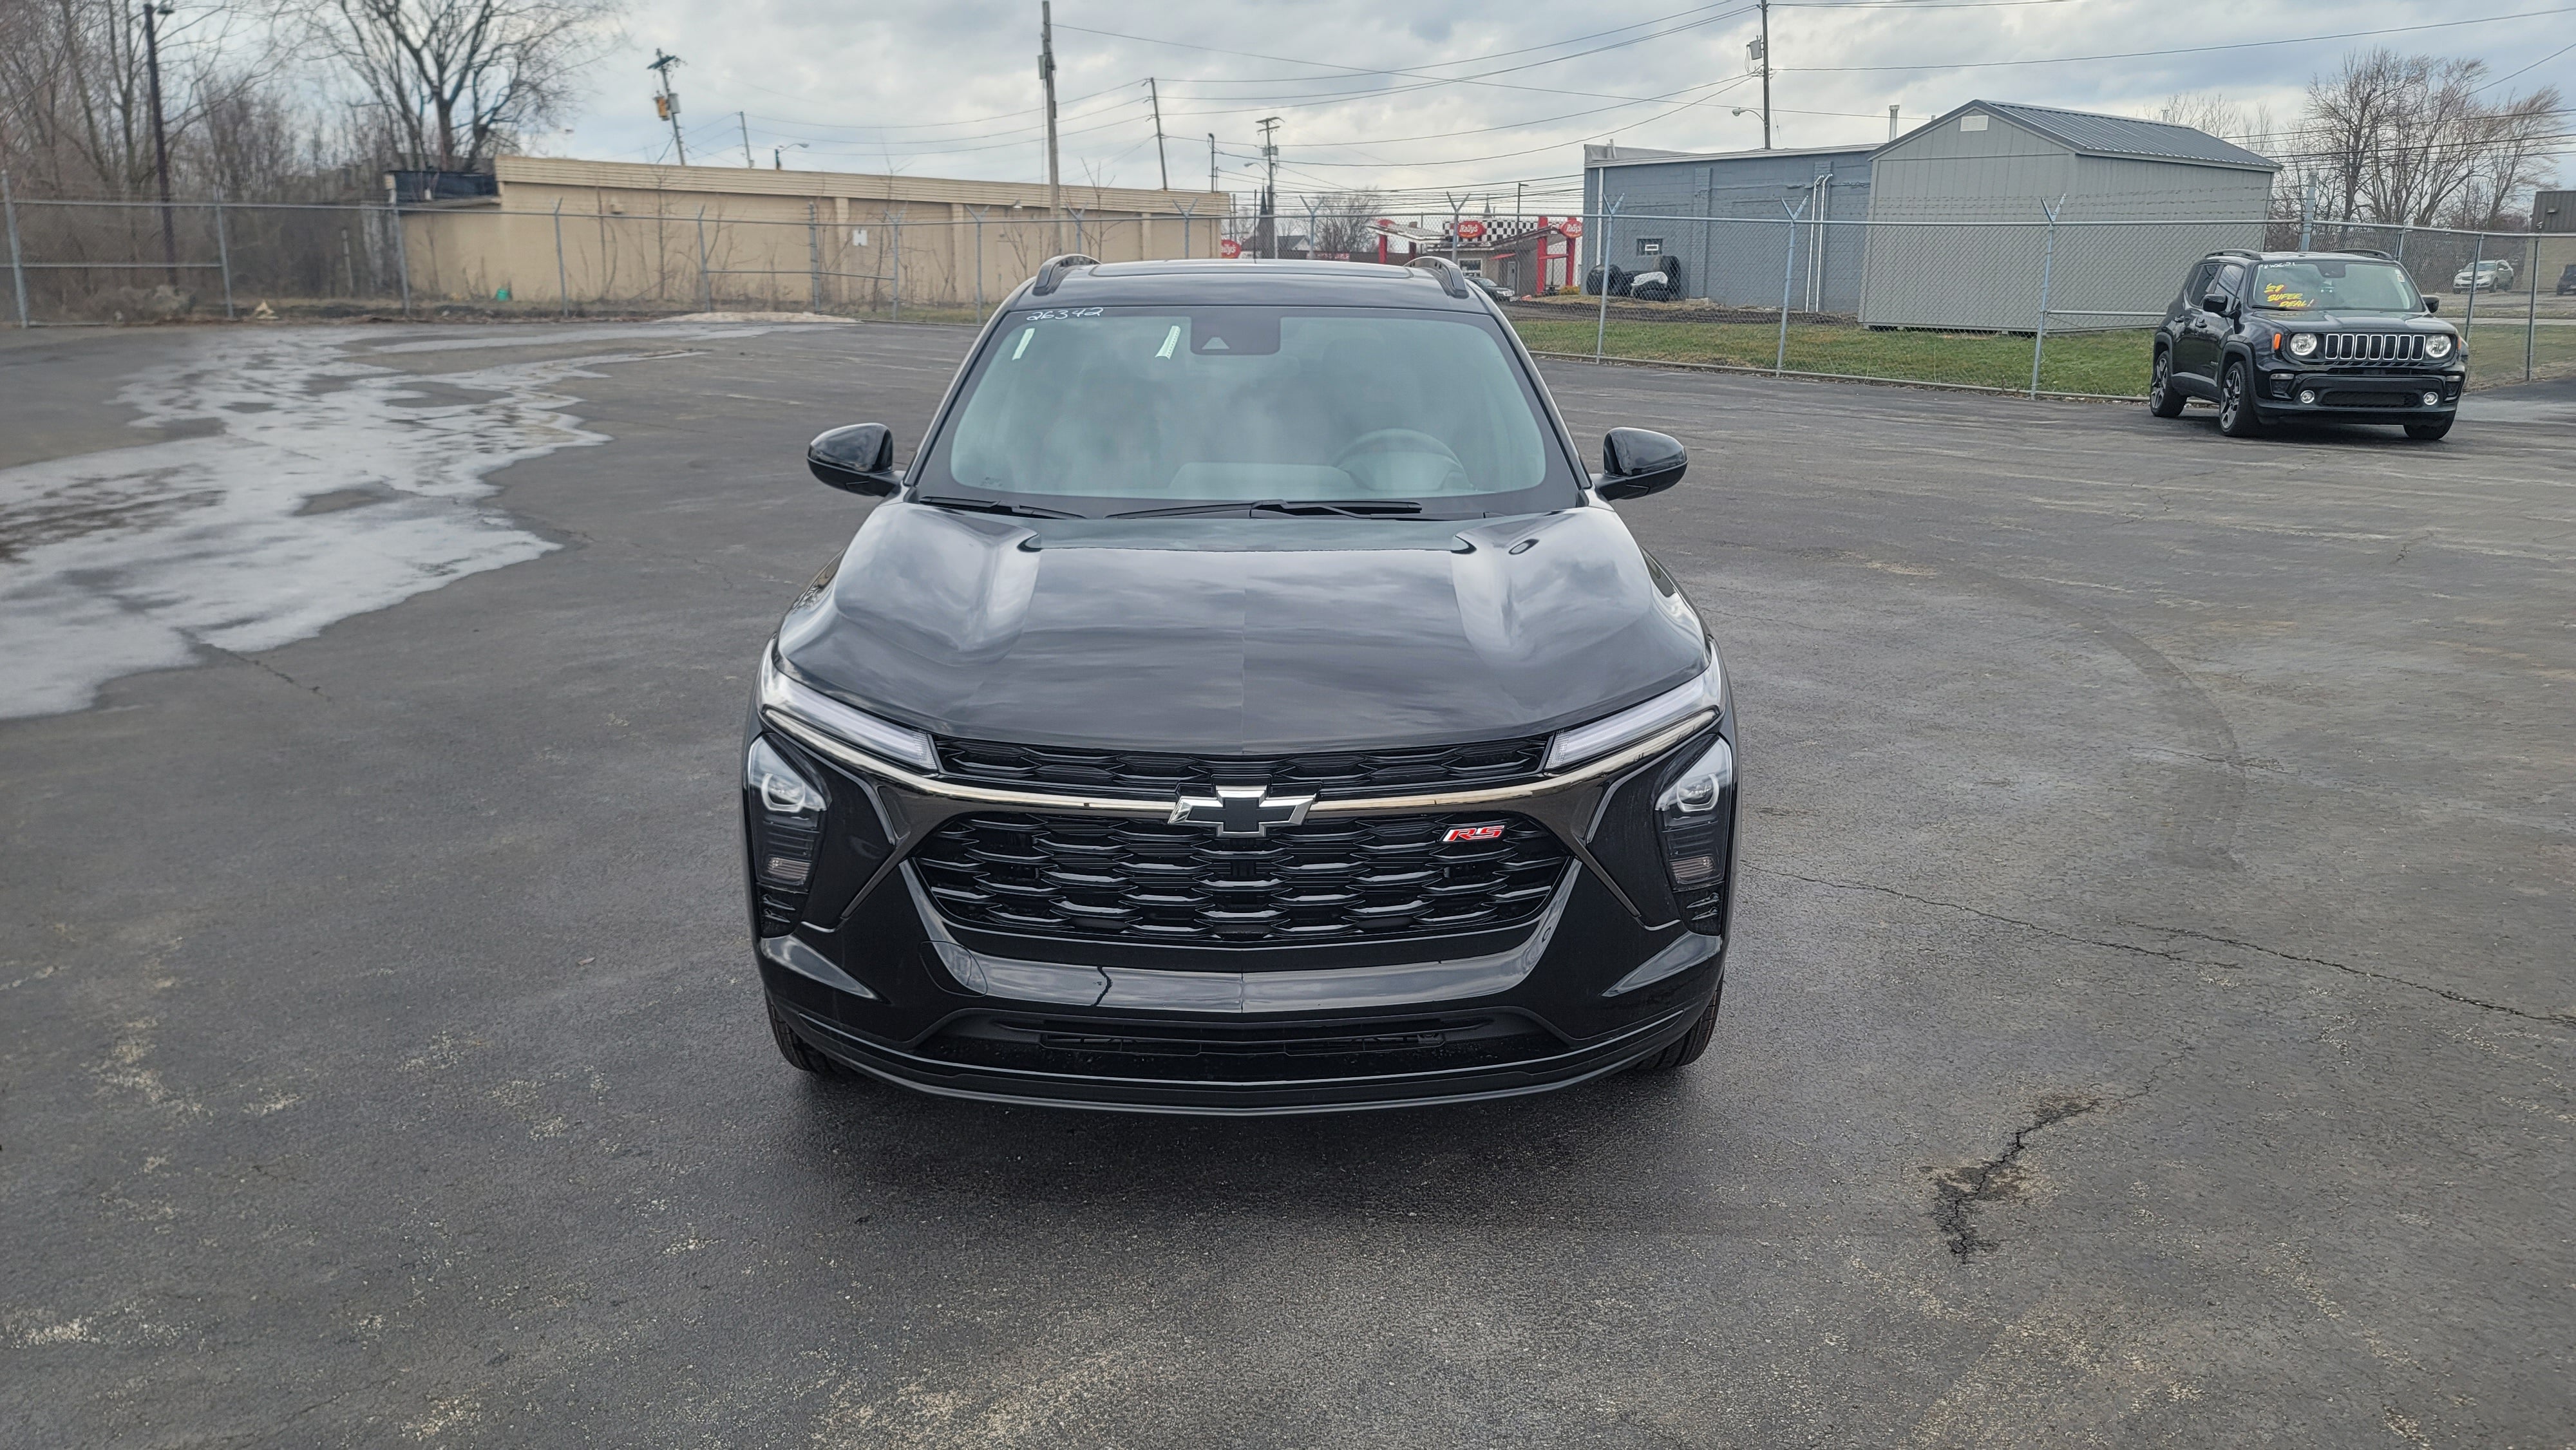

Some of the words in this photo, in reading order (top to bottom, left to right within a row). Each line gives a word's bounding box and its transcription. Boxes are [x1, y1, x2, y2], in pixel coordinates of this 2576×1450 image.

[1459, 223, 1479, 234] Rally's
[1221, 244, 1236, 255] ally's
[2267, 293, 2303, 302] SUPER
[1026, 306, 1104, 321] 26342
[1443, 825, 1505, 842] RS
